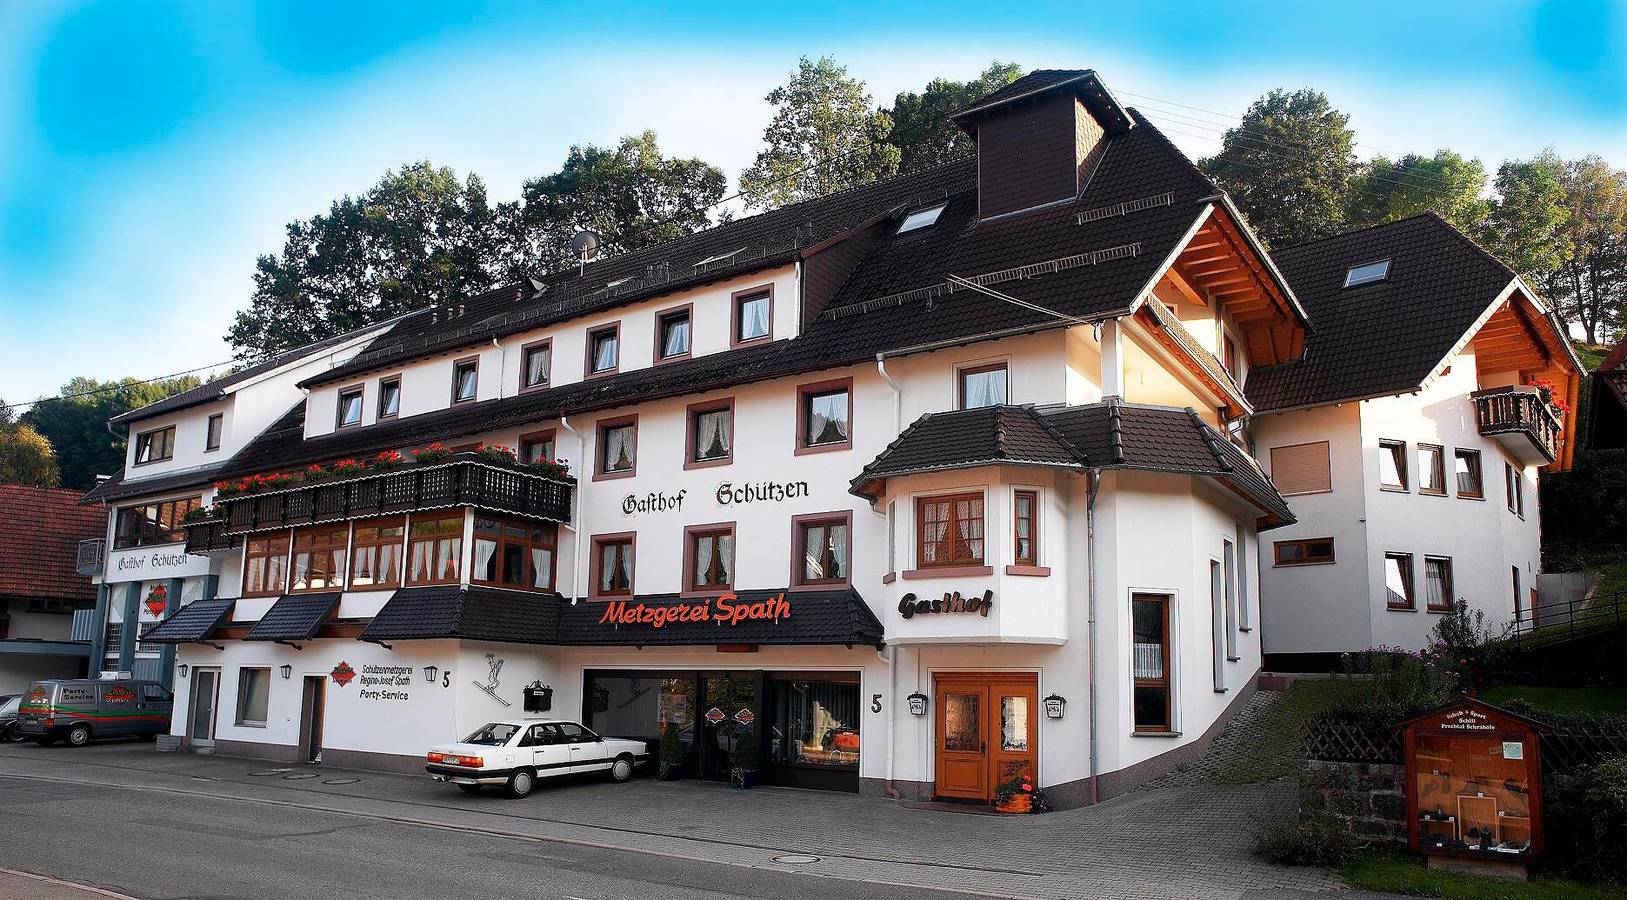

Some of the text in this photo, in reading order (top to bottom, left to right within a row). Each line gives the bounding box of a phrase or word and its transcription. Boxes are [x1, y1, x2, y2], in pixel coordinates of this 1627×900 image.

[622, 480, 809, 515] Gasthof Schützen
[152, 553, 187, 567] Schützen
[599, 592, 791, 628] Metzgerei Spath
[898, 589, 993, 619] Gasthof
[442, 670, 450, 688] 5
[359, 689, 409, 700] Party-Service
[871, 694, 883, 713] 5
[1470, 710, 1487, 719] Sport
